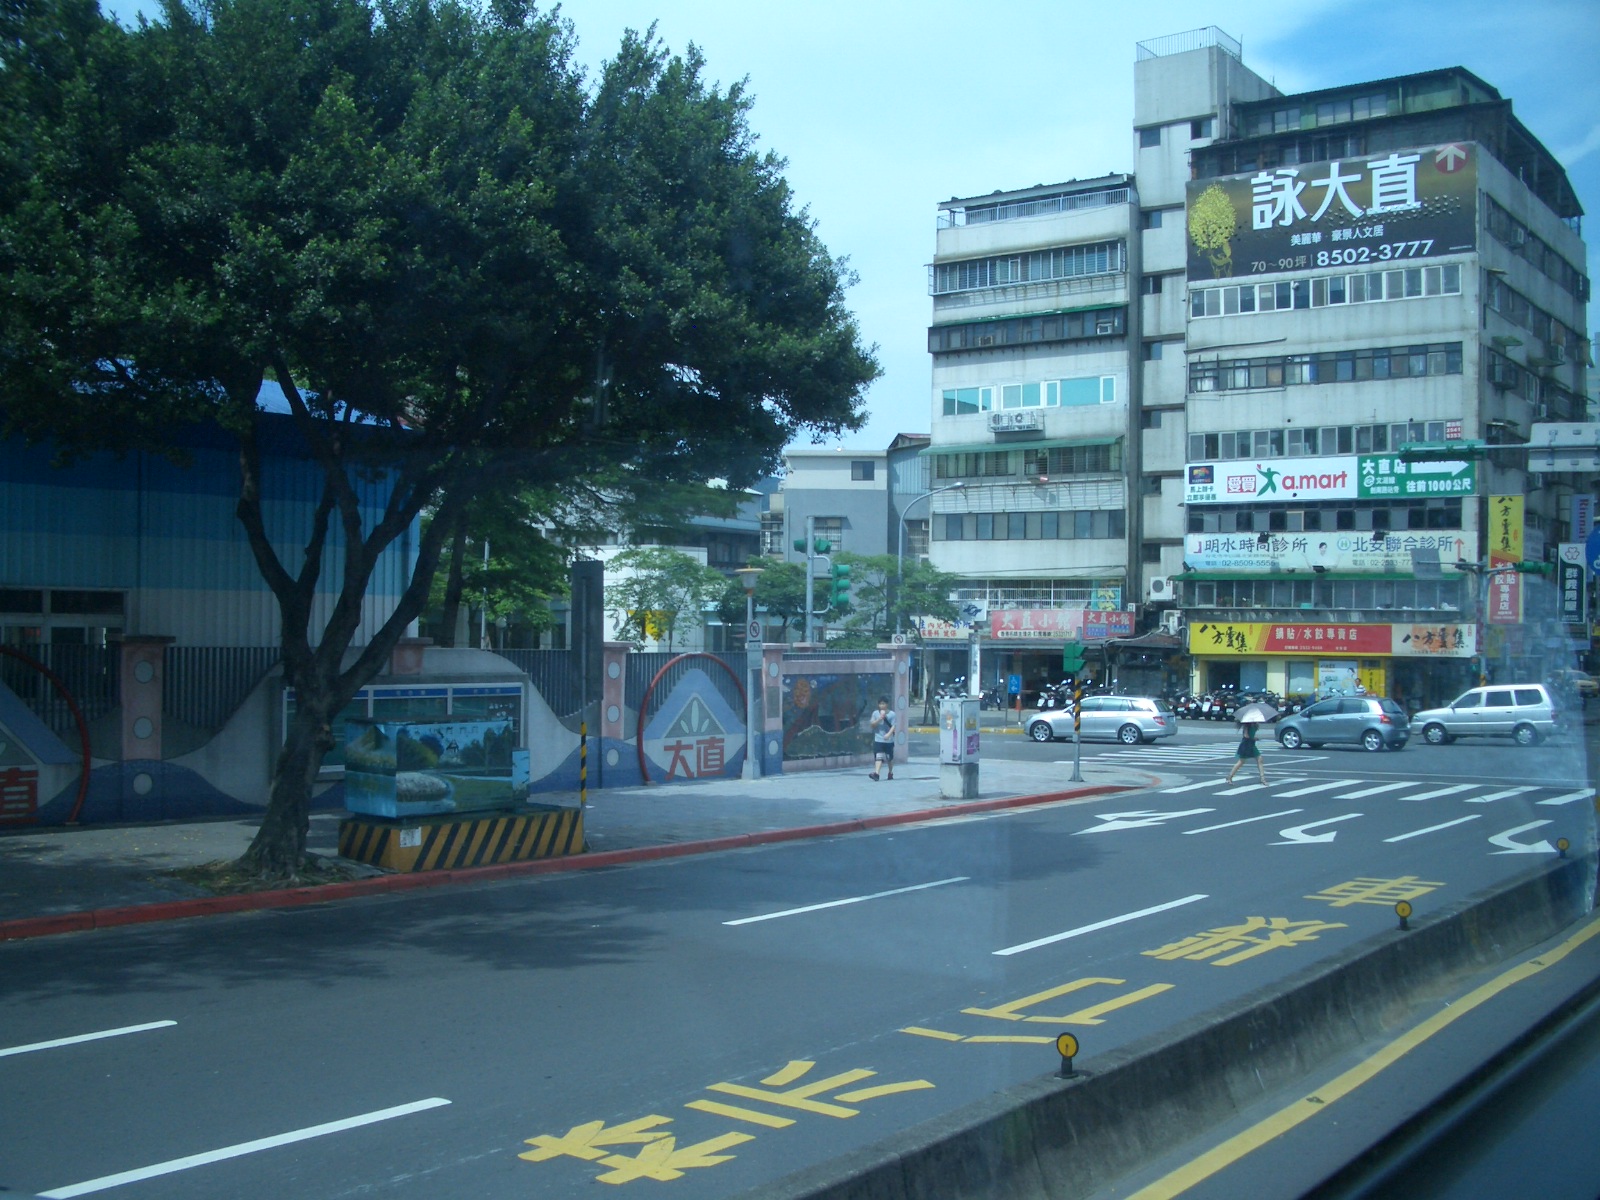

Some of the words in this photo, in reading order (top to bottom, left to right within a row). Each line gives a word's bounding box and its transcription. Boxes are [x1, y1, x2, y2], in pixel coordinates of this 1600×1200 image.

[1250, 153, 1422, 231] 詠大直
[1316, 239, 1434, 267] 8502-3777
[1361, 459, 1407, 475] 大直店
[1281, 470, 1348, 491] a.mart
[1204, 536, 1309, 554] 明水時尚診所
[1352, 535, 1453, 553] 北安聯合診所
[1199, 623, 1250, 653] 八方雲集
[663, 736, 726, 782] 大直
